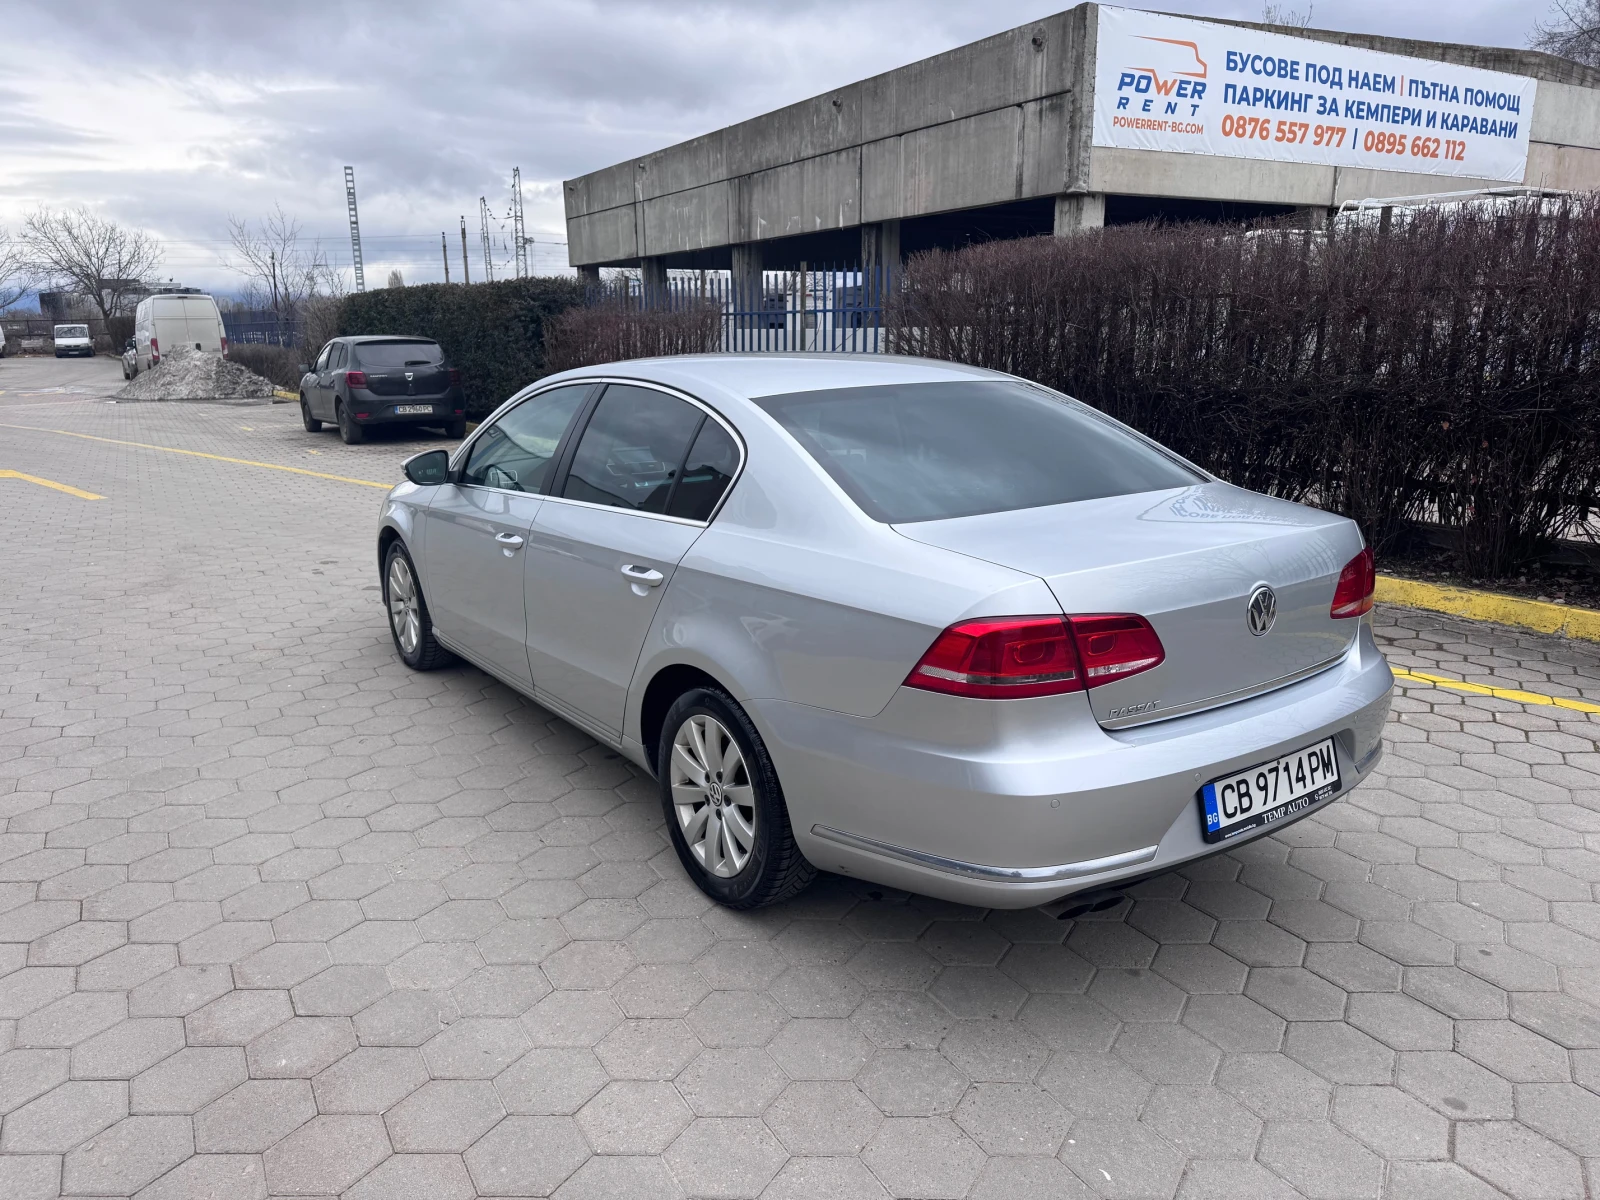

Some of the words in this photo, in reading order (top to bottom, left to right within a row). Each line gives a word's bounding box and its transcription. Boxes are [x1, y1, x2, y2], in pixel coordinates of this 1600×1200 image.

[1117, 70, 1207, 100] POWER
[1225, 50, 1300, 81] БУСОВЕ
[1305, 62, 1343, 90] ПОД
[1348, 69, 1396, 94] НАЕМ
[1408, 78, 1460, 104] ПЪТНА
[1463, 87, 1521, 116] ПОМОЩ
[1116, 96, 1200, 117] RENT
[1223, 83, 1313, 113] ПАРКИНГ
[1316, 95, 1339, 117] ЗА
[1344, 99, 1422, 127] КЕМПЕРИ
[1426, 110, 1437, 129] И
[1440, 111, 1518, 139] КАРАВАНИ
[1113, 115, 1204, 135] POWERRENT-BG.COM
[1221, 114, 1271, 141] 0876
[1274, 120, 1310, 144] 557
[1312, 124, 1347, 148] 977
[1363, 129, 1407, 155] 0895
[1410, 135, 1441, 159] 662
[1444, 139, 1466, 162] 112
[1108, 700, 1161, 719] PASSAT
[1207, 812, 1219, 825] BG
[1261, 807, 1286, 824] TEMP
[1287, 797, 1309, 815] AUTO
